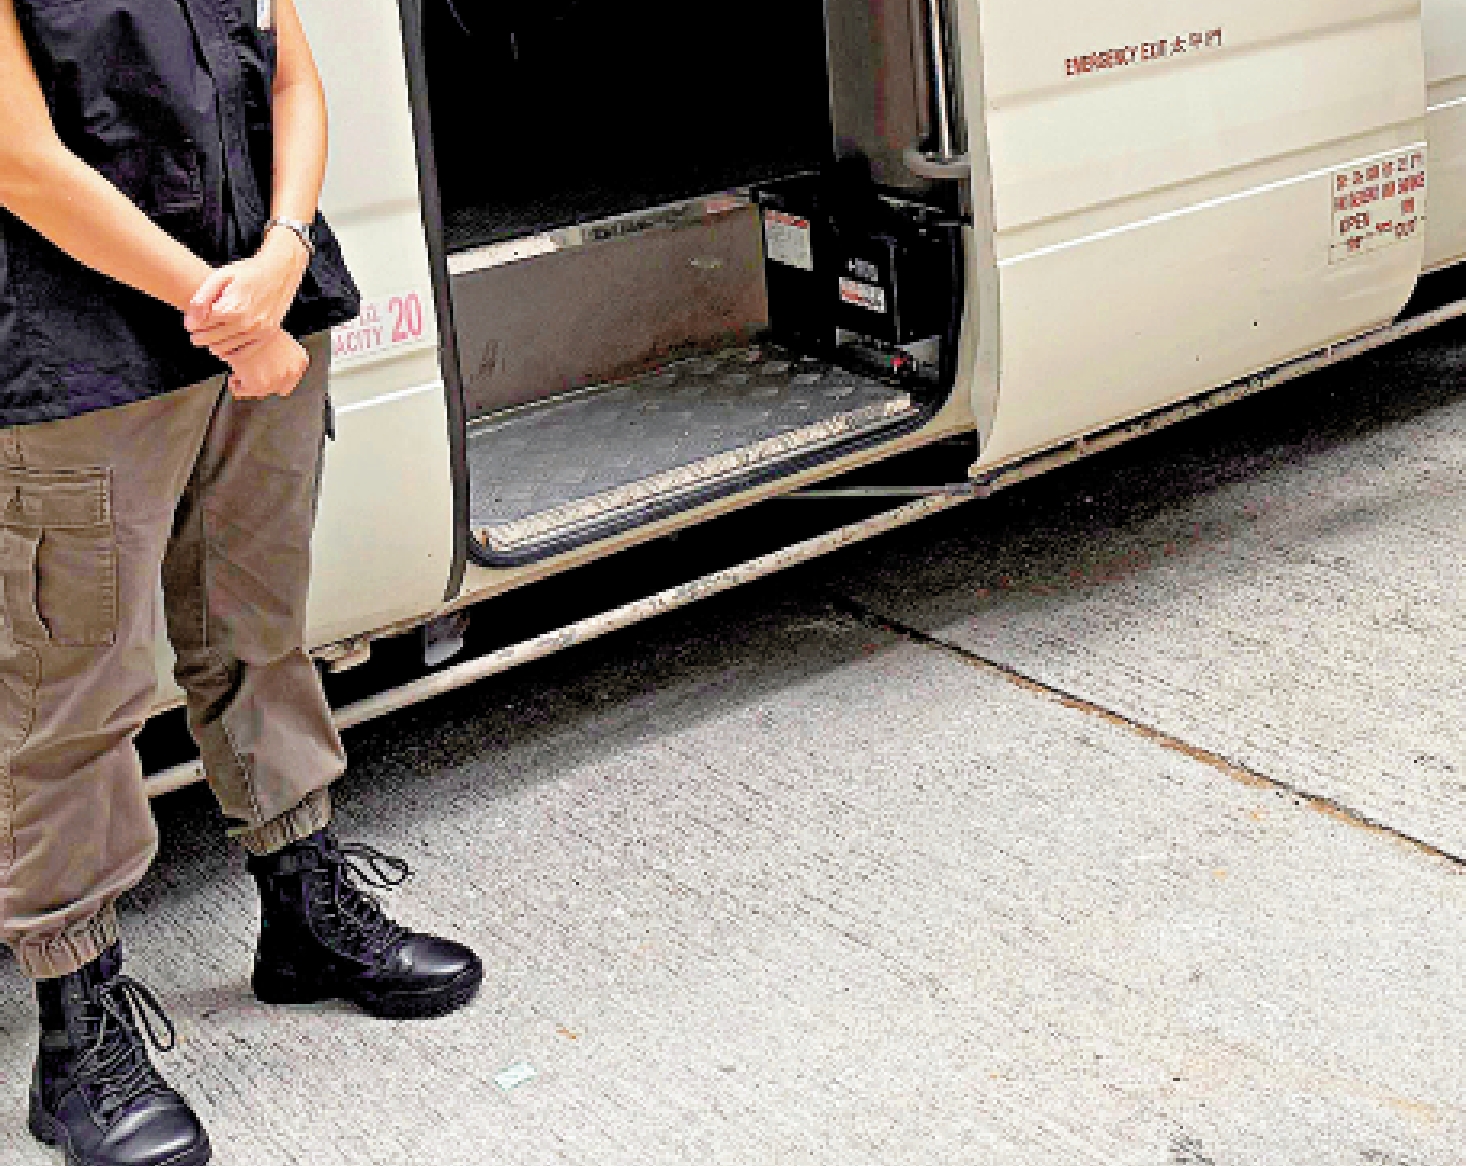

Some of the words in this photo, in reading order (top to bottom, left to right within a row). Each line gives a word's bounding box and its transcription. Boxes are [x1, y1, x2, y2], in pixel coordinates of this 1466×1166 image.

[1064, 45, 1138, 76] EMERGENCY
[1140, 38, 1168, 63] EXIT
[388, 290, 422, 343] 20
[332, 324, 384, 356] ACITY
